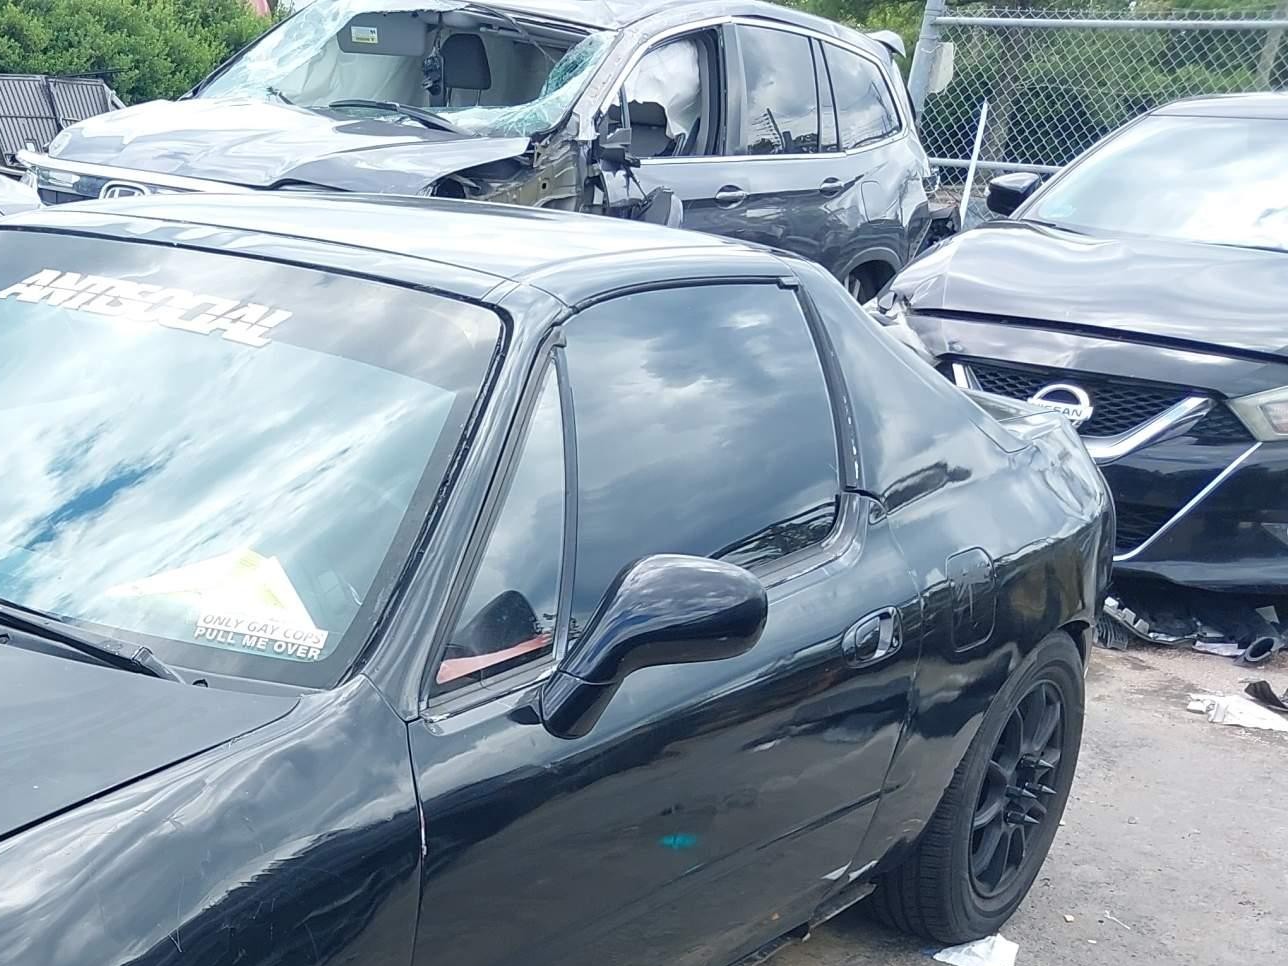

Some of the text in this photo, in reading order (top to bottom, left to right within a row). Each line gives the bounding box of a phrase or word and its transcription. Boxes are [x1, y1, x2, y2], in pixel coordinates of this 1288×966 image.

[194, 627, 321, 660] PULL ME OVER
[202, 614, 323, 645] ONLY GAY COPS
